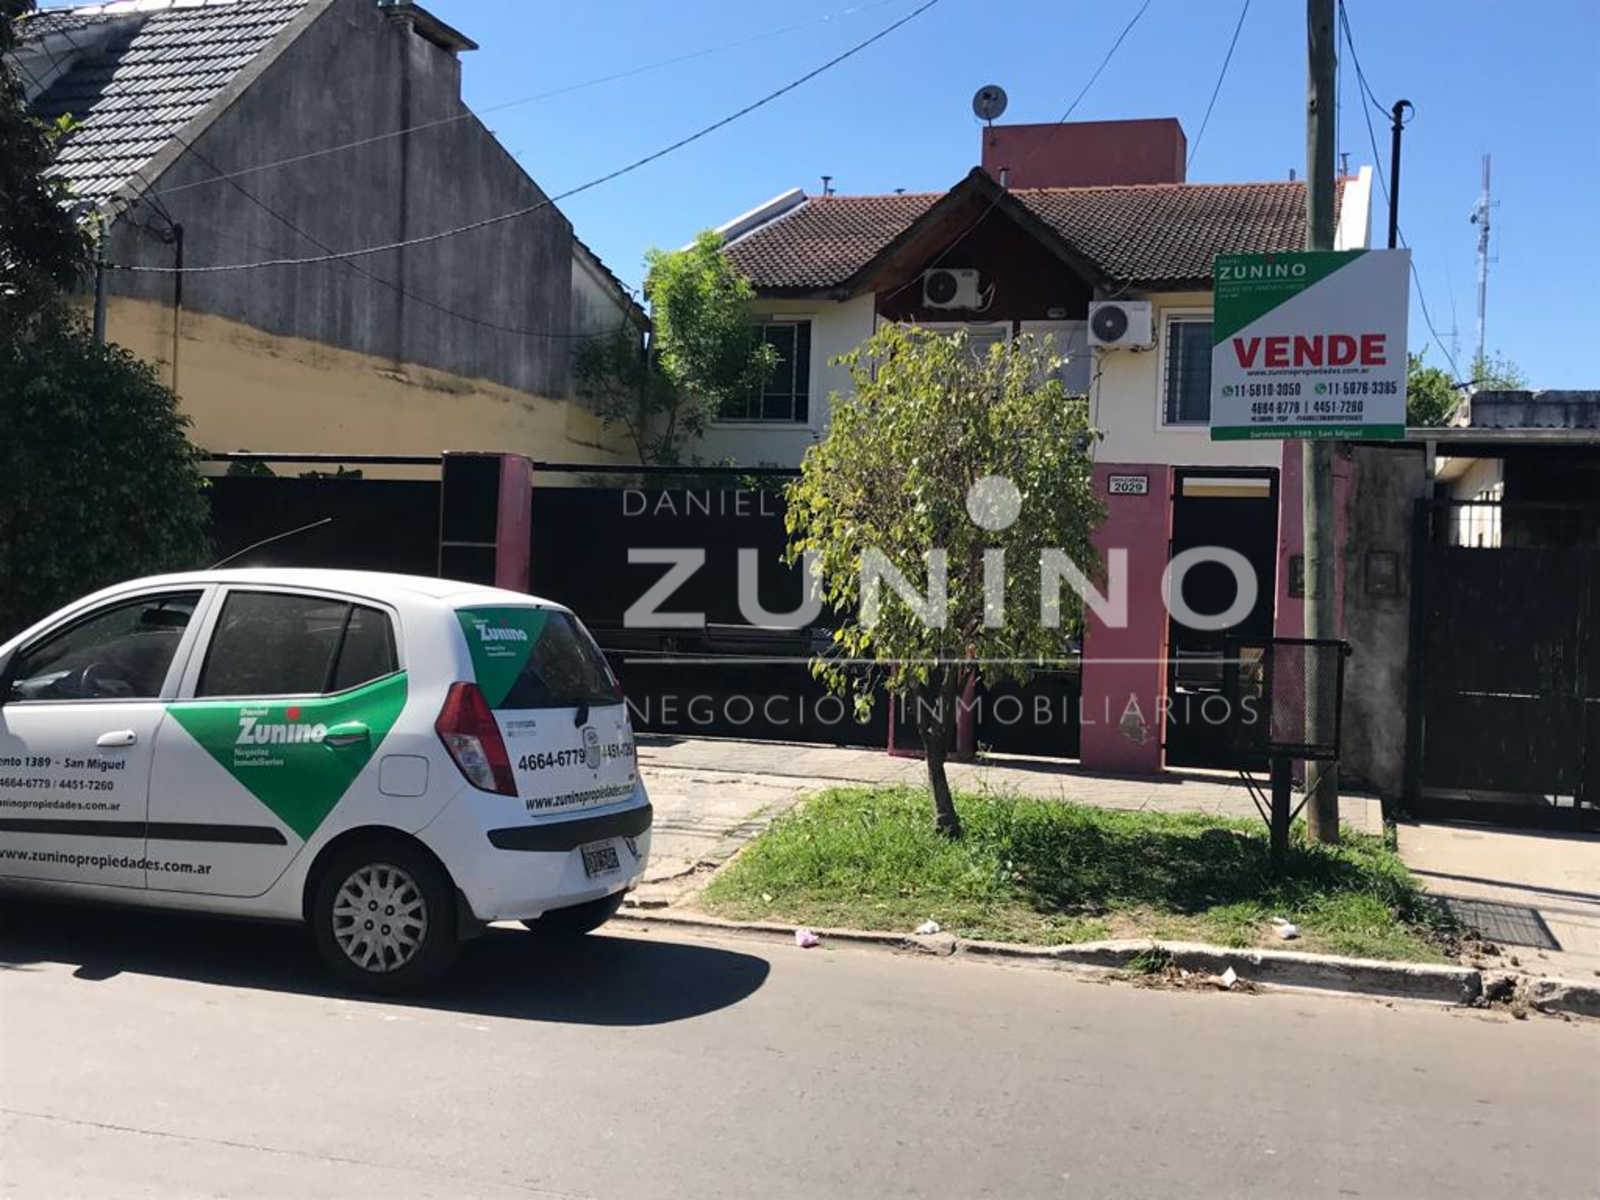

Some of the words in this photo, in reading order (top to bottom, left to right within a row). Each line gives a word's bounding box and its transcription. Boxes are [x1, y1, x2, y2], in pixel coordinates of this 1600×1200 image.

[1219, 263, 1307, 280] ZUNINO
[1233, 333, 1387, 369] VENDE
[1114, 482, 1143, 493] 2029
[235, 716, 327, 745] Zunino
[25, 756, 52, 768] 1389
[64, 758, 84, 769] San
[87, 759, 126, 773] Miguel
[518, 748, 586, 771] 4664-6779
[59, 780, 115, 791] 4451-7260
